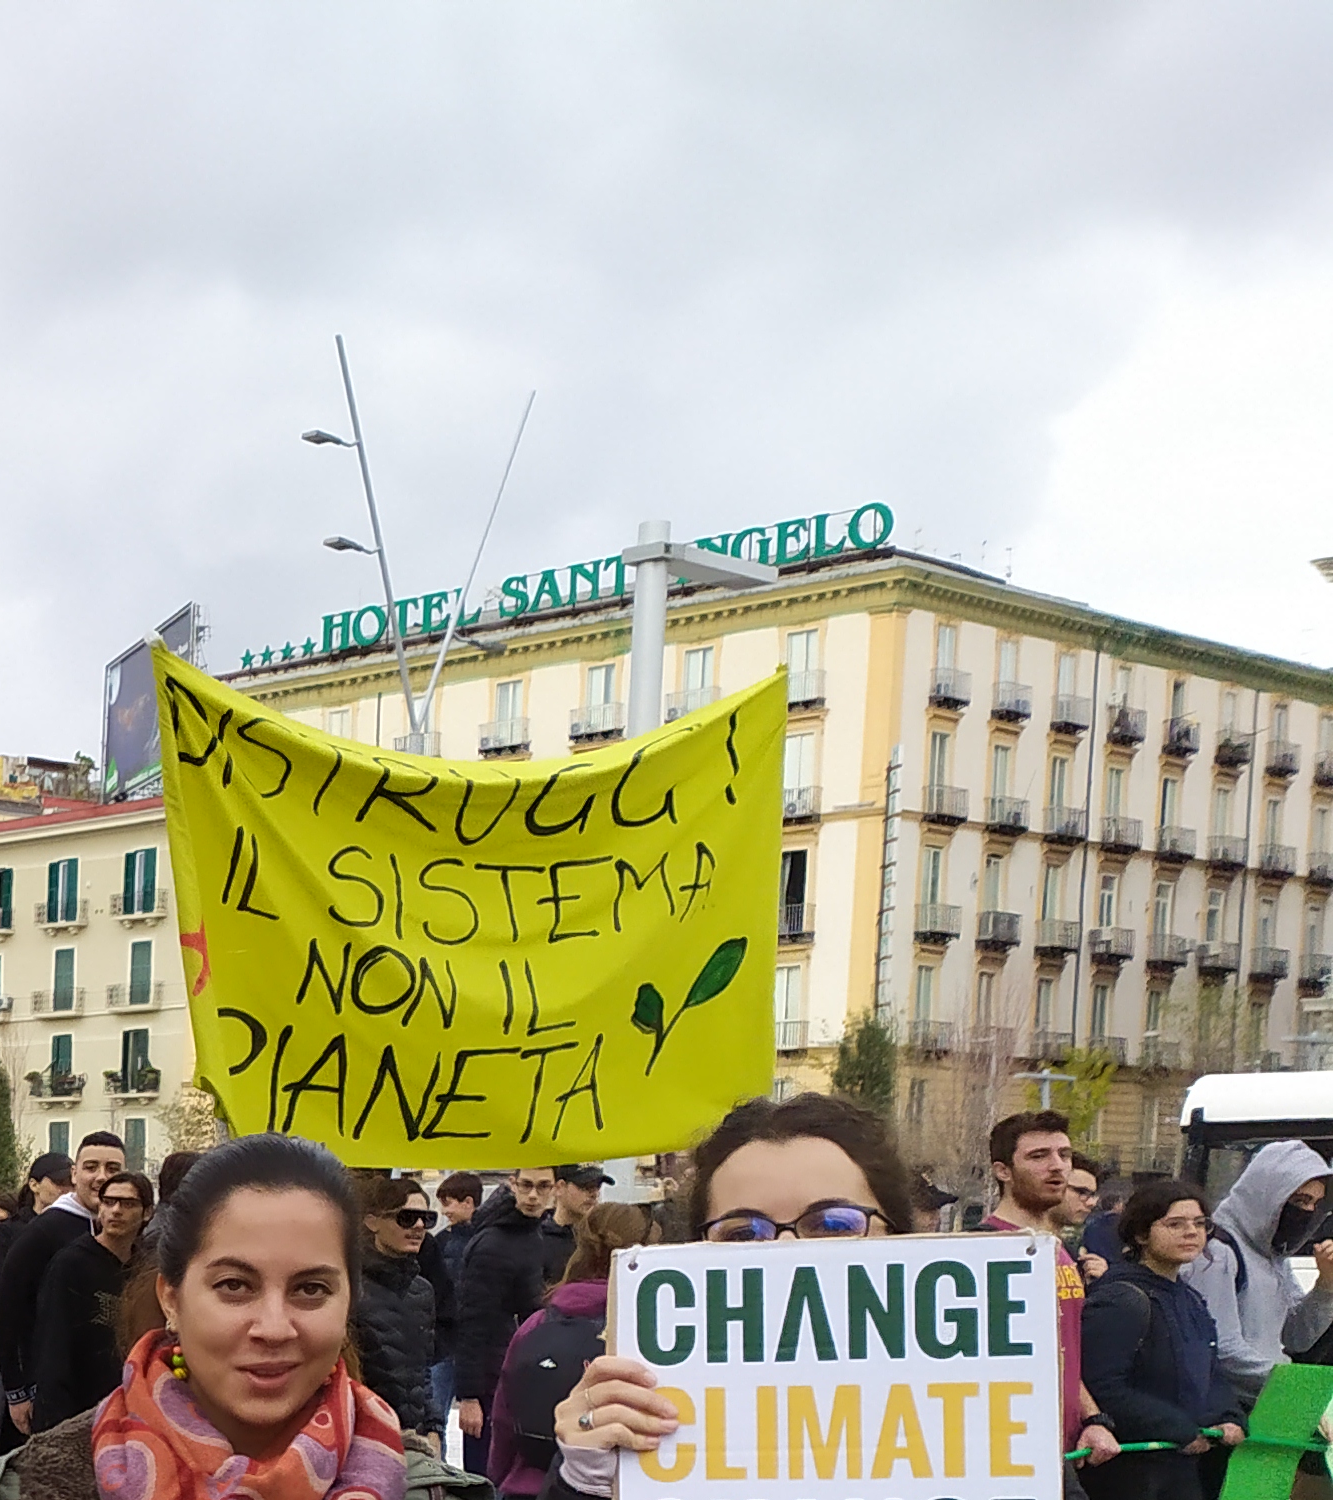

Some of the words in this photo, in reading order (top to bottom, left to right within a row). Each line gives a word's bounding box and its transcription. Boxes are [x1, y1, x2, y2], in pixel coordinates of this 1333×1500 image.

[320, 586, 482, 653] HOTEL
[222, 826, 280, 921] IL
[328, 841, 719, 945] SISTEMA
[295, 937, 458, 1030] NON
[499, 957, 577, 1035] IL
[635, 1259, 1034, 1367] CHANGE
[637, 1381, 1036, 1483] CLIMATE
